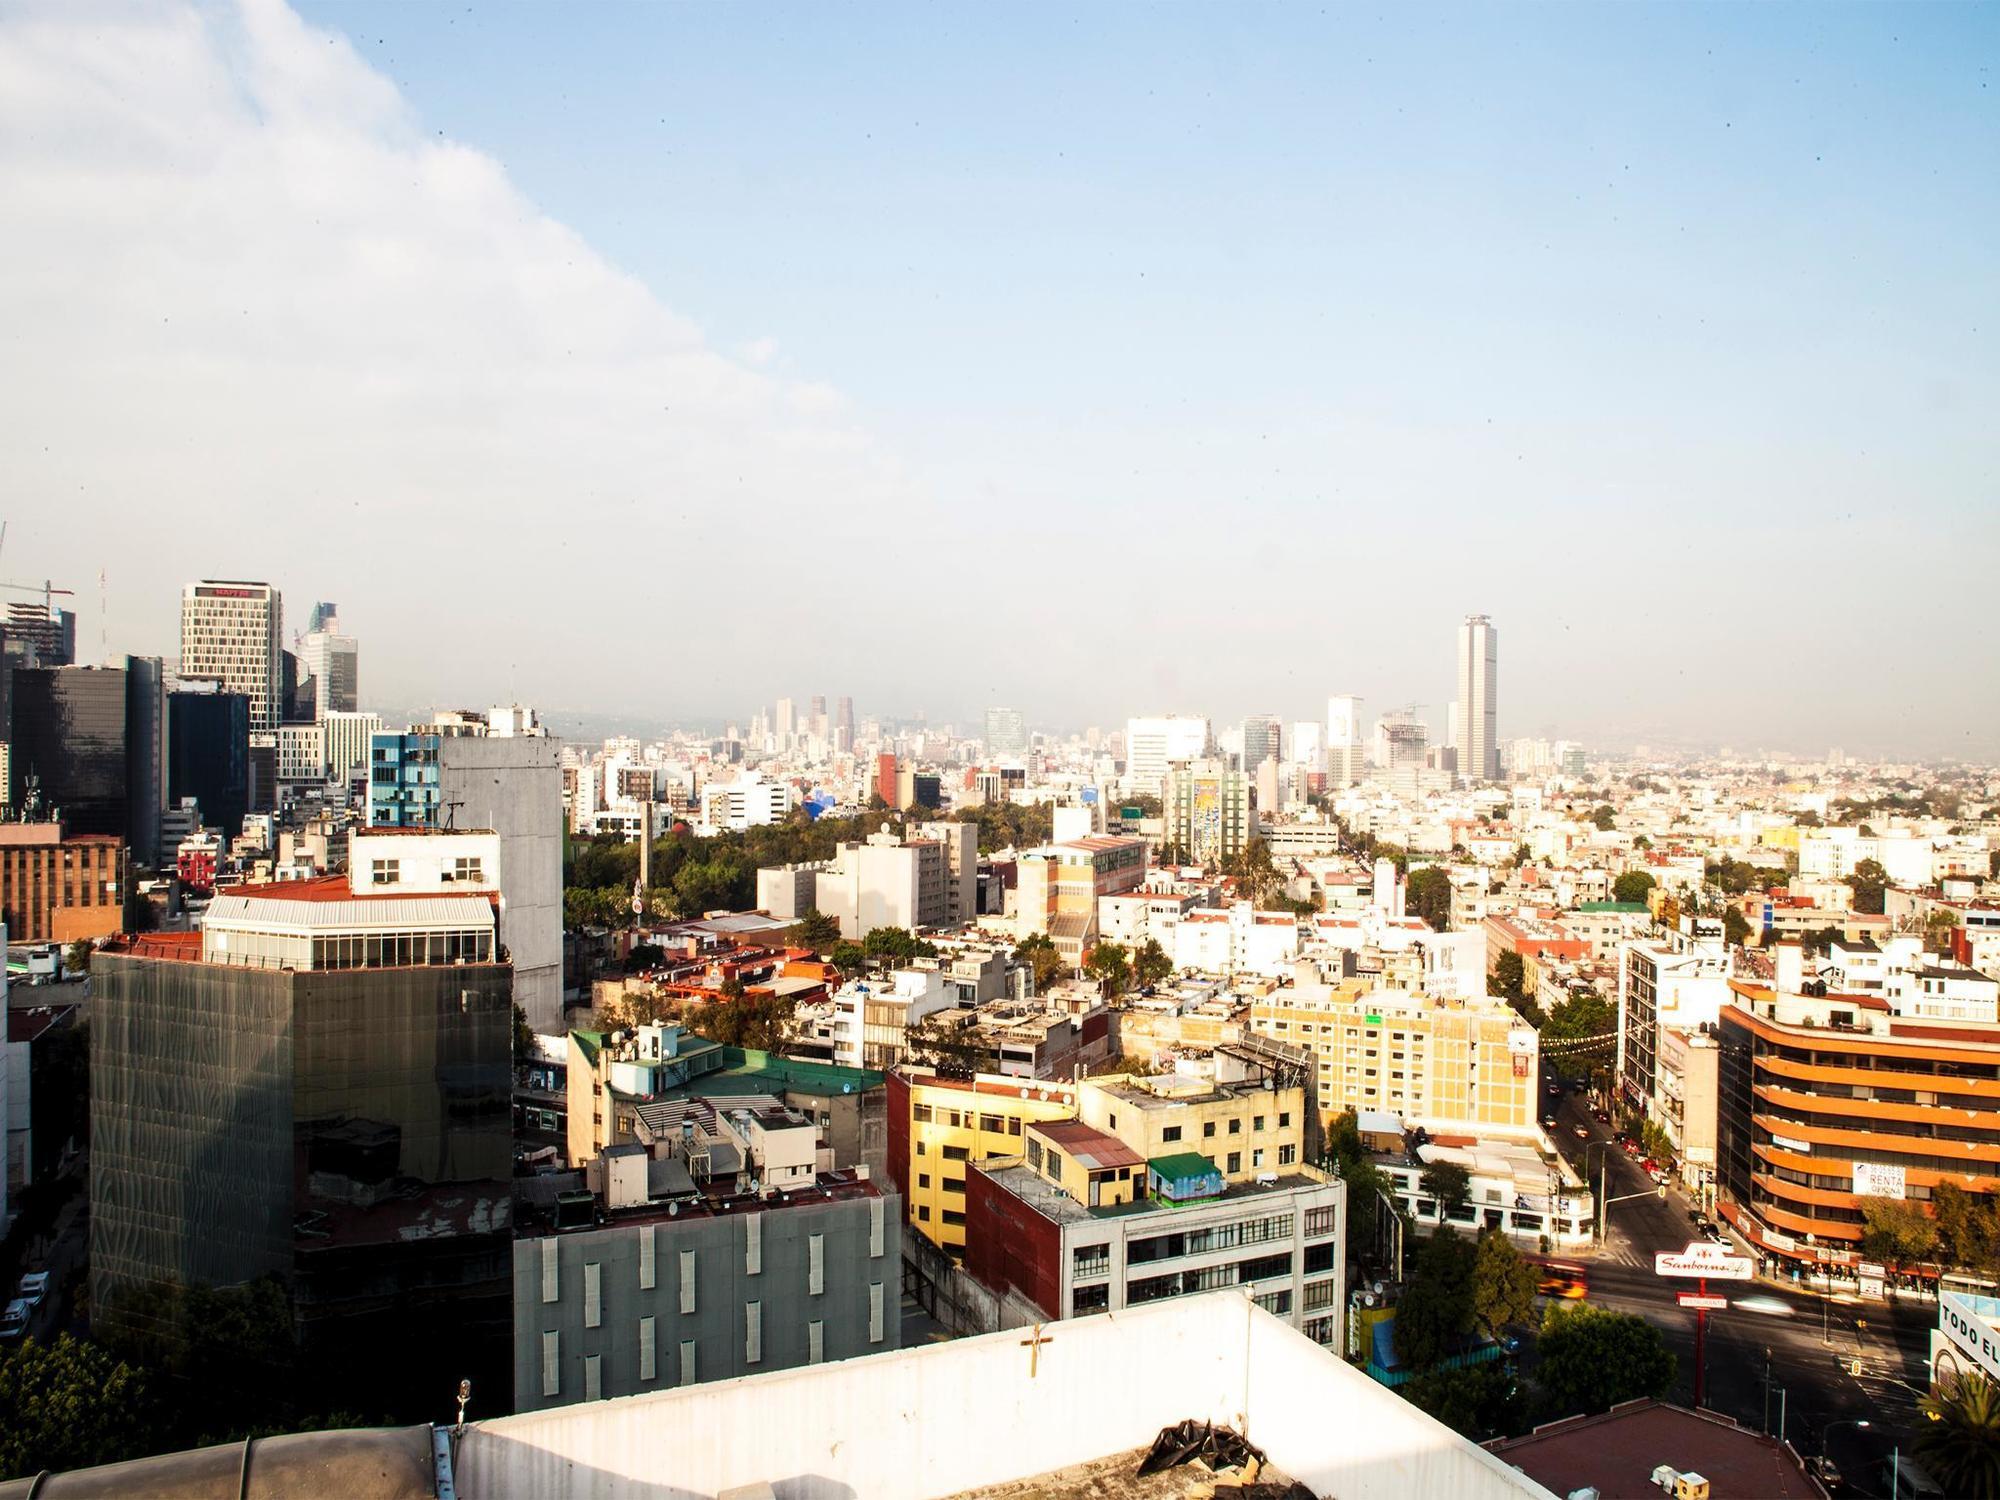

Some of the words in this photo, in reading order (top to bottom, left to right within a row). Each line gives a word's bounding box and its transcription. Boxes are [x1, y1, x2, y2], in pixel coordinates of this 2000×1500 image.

[1870, 1174, 1903, 1187] RENTA
[1943, 1305, 1977, 1344] TODO
[1982, 1338, 1999, 1363] EL
